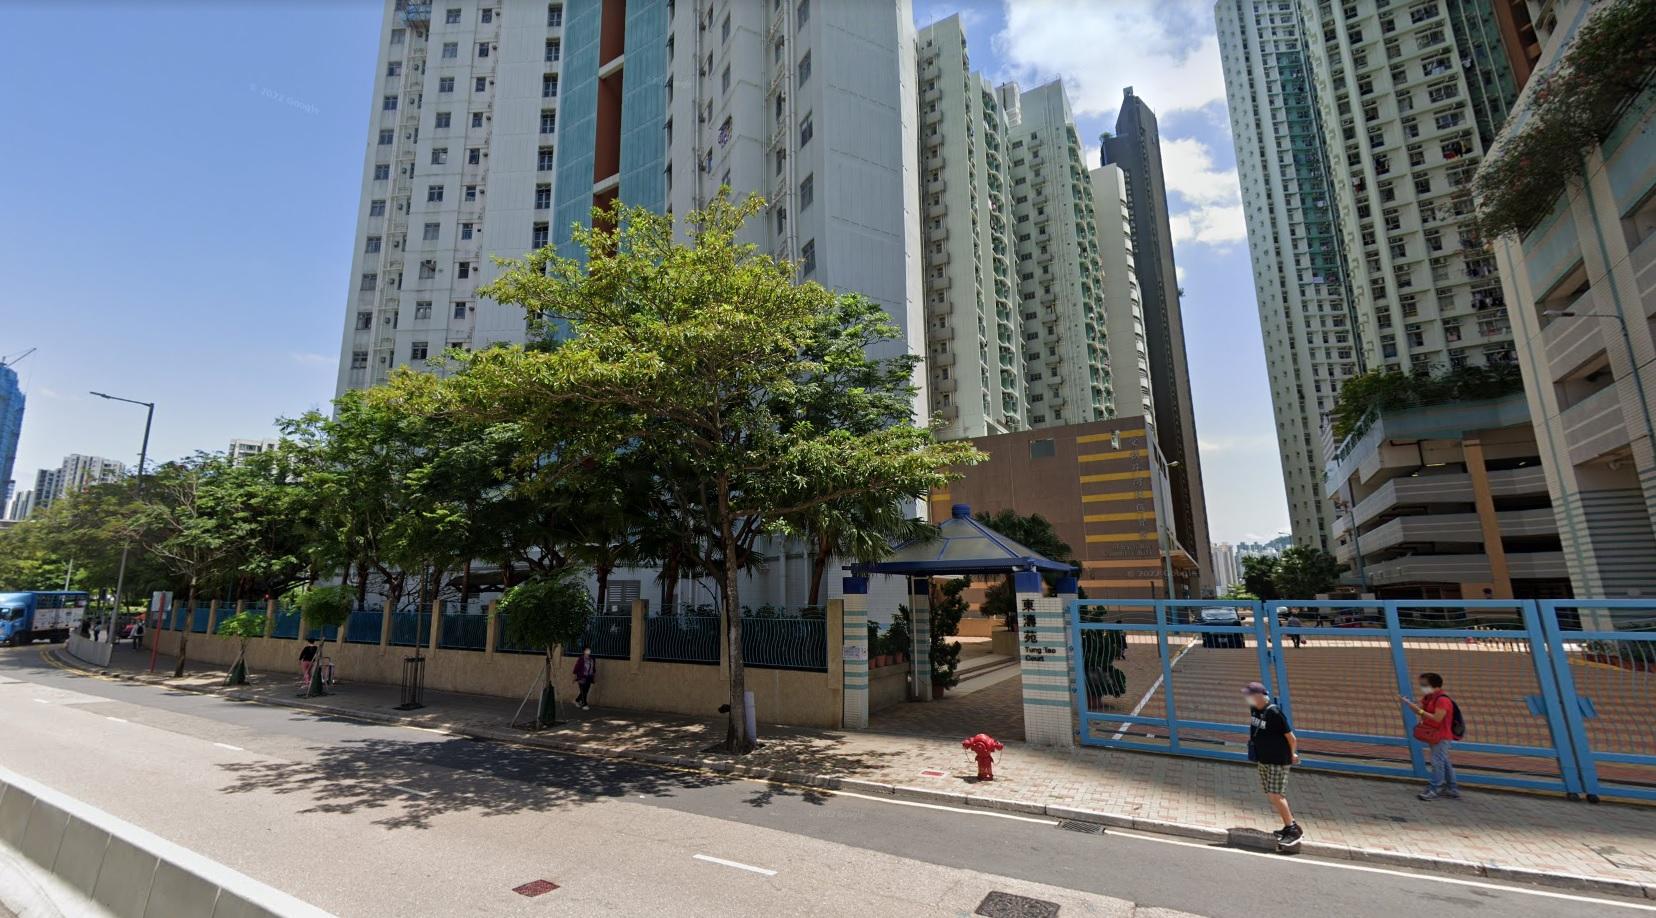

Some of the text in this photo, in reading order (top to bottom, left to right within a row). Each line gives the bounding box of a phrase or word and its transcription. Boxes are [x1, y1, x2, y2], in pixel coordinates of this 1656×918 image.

[1024, 646, 1056, 654] Tung Tao
[1025, 654, 1044, 662] Court
